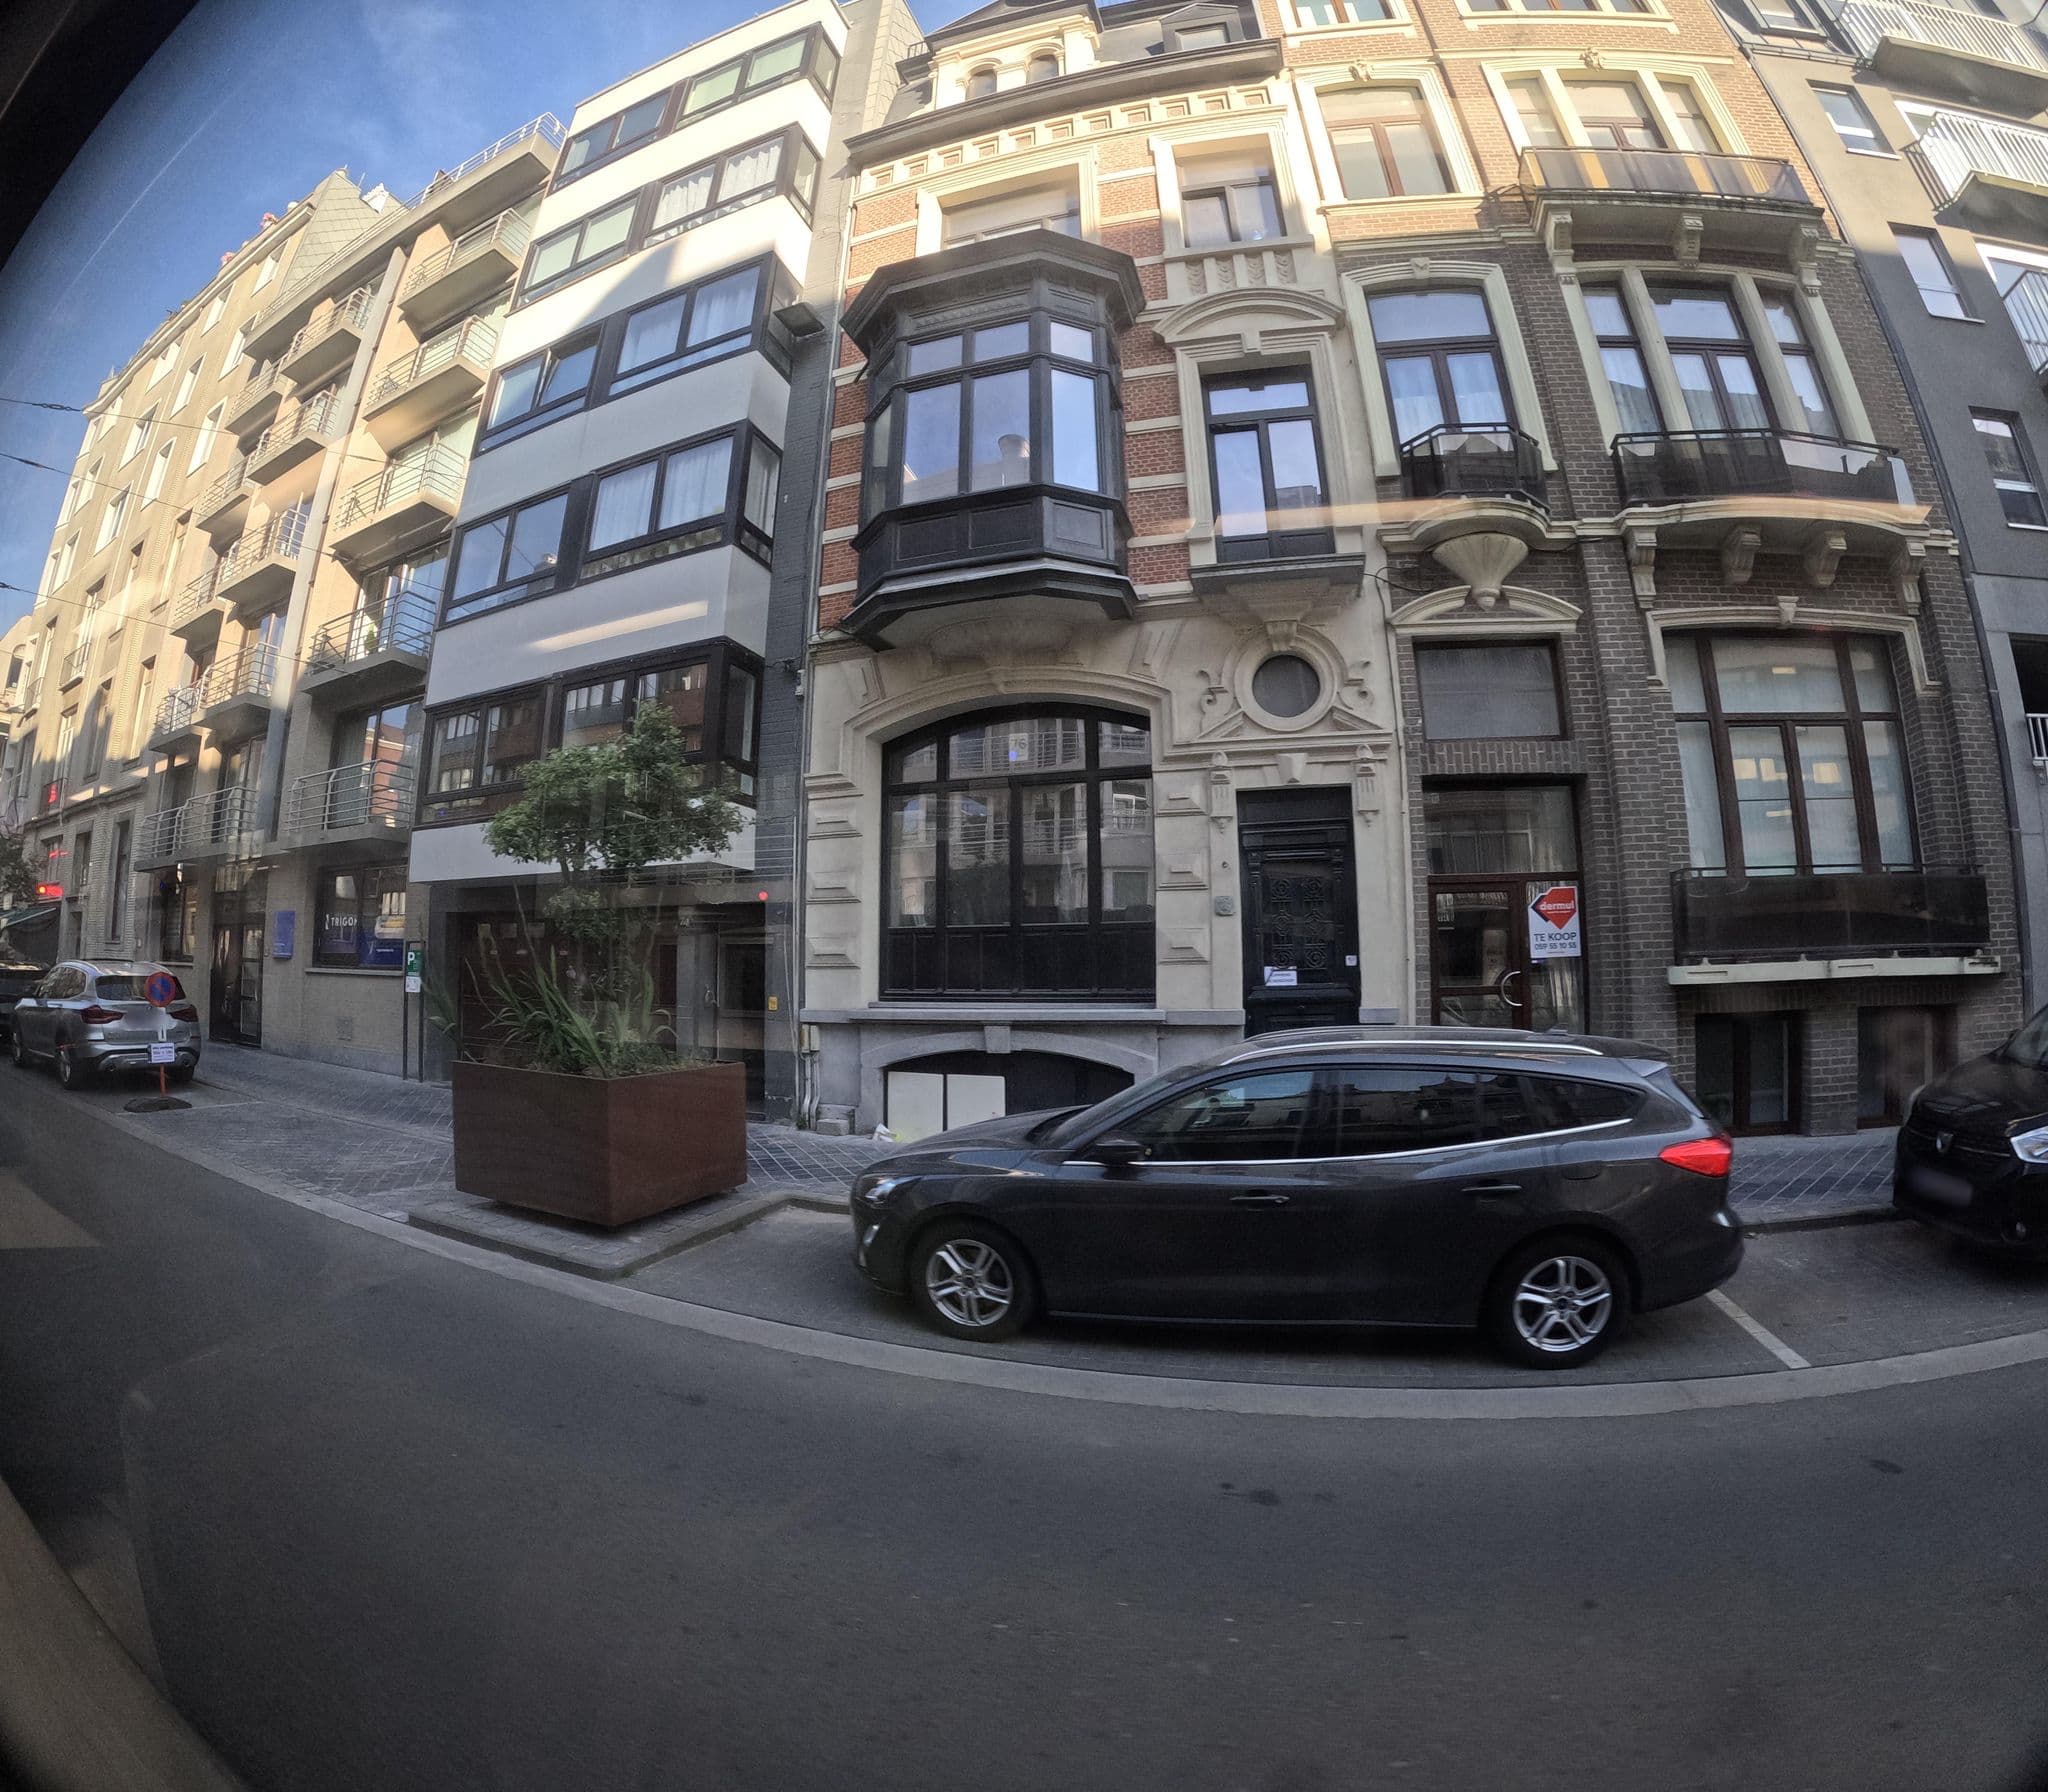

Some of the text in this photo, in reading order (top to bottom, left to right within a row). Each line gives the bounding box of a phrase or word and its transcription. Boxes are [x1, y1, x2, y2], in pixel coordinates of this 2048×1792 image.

[1539, 900, 1575, 910] dermul
[1534, 932, 1577, 942] TE KOOP
[408, 952, 415, 965] P
